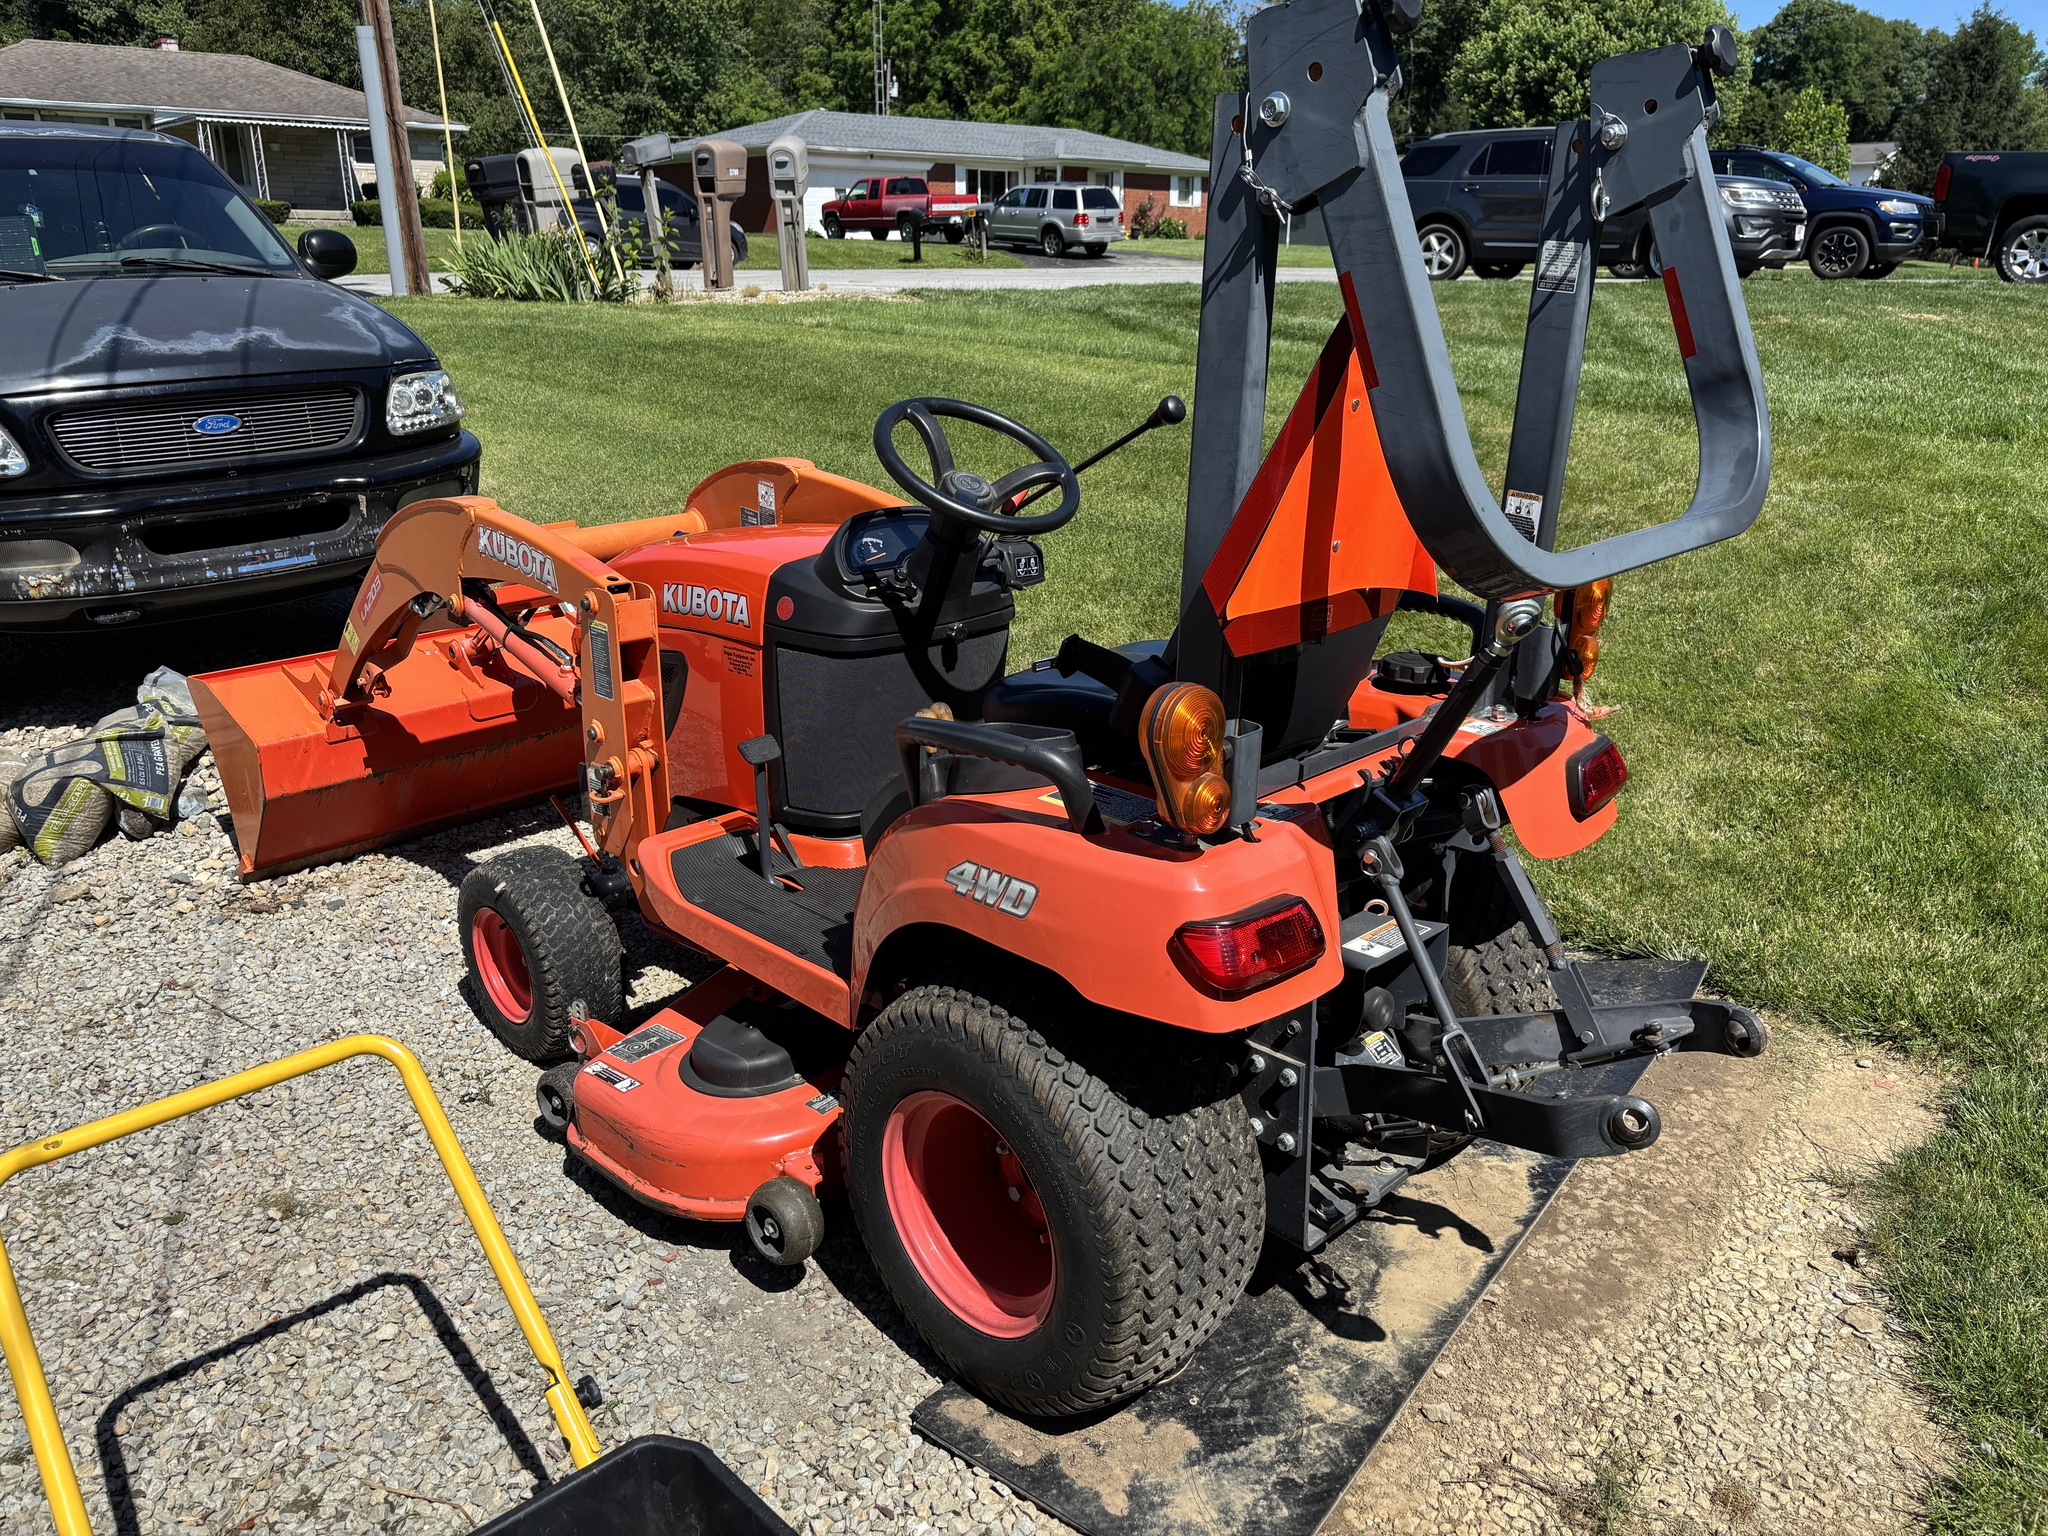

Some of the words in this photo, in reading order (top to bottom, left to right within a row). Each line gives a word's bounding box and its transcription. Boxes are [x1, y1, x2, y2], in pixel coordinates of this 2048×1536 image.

[1515, 491, 1540, 501] WARNING
[478, 525, 558, 593] KUBOTA
[361, 574, 381, 621] LA203
[663, 583, 751, 628] KUBOTA
[155, 762, 165, 776] PEA
[944, 859, 1039, 919] 4WD
